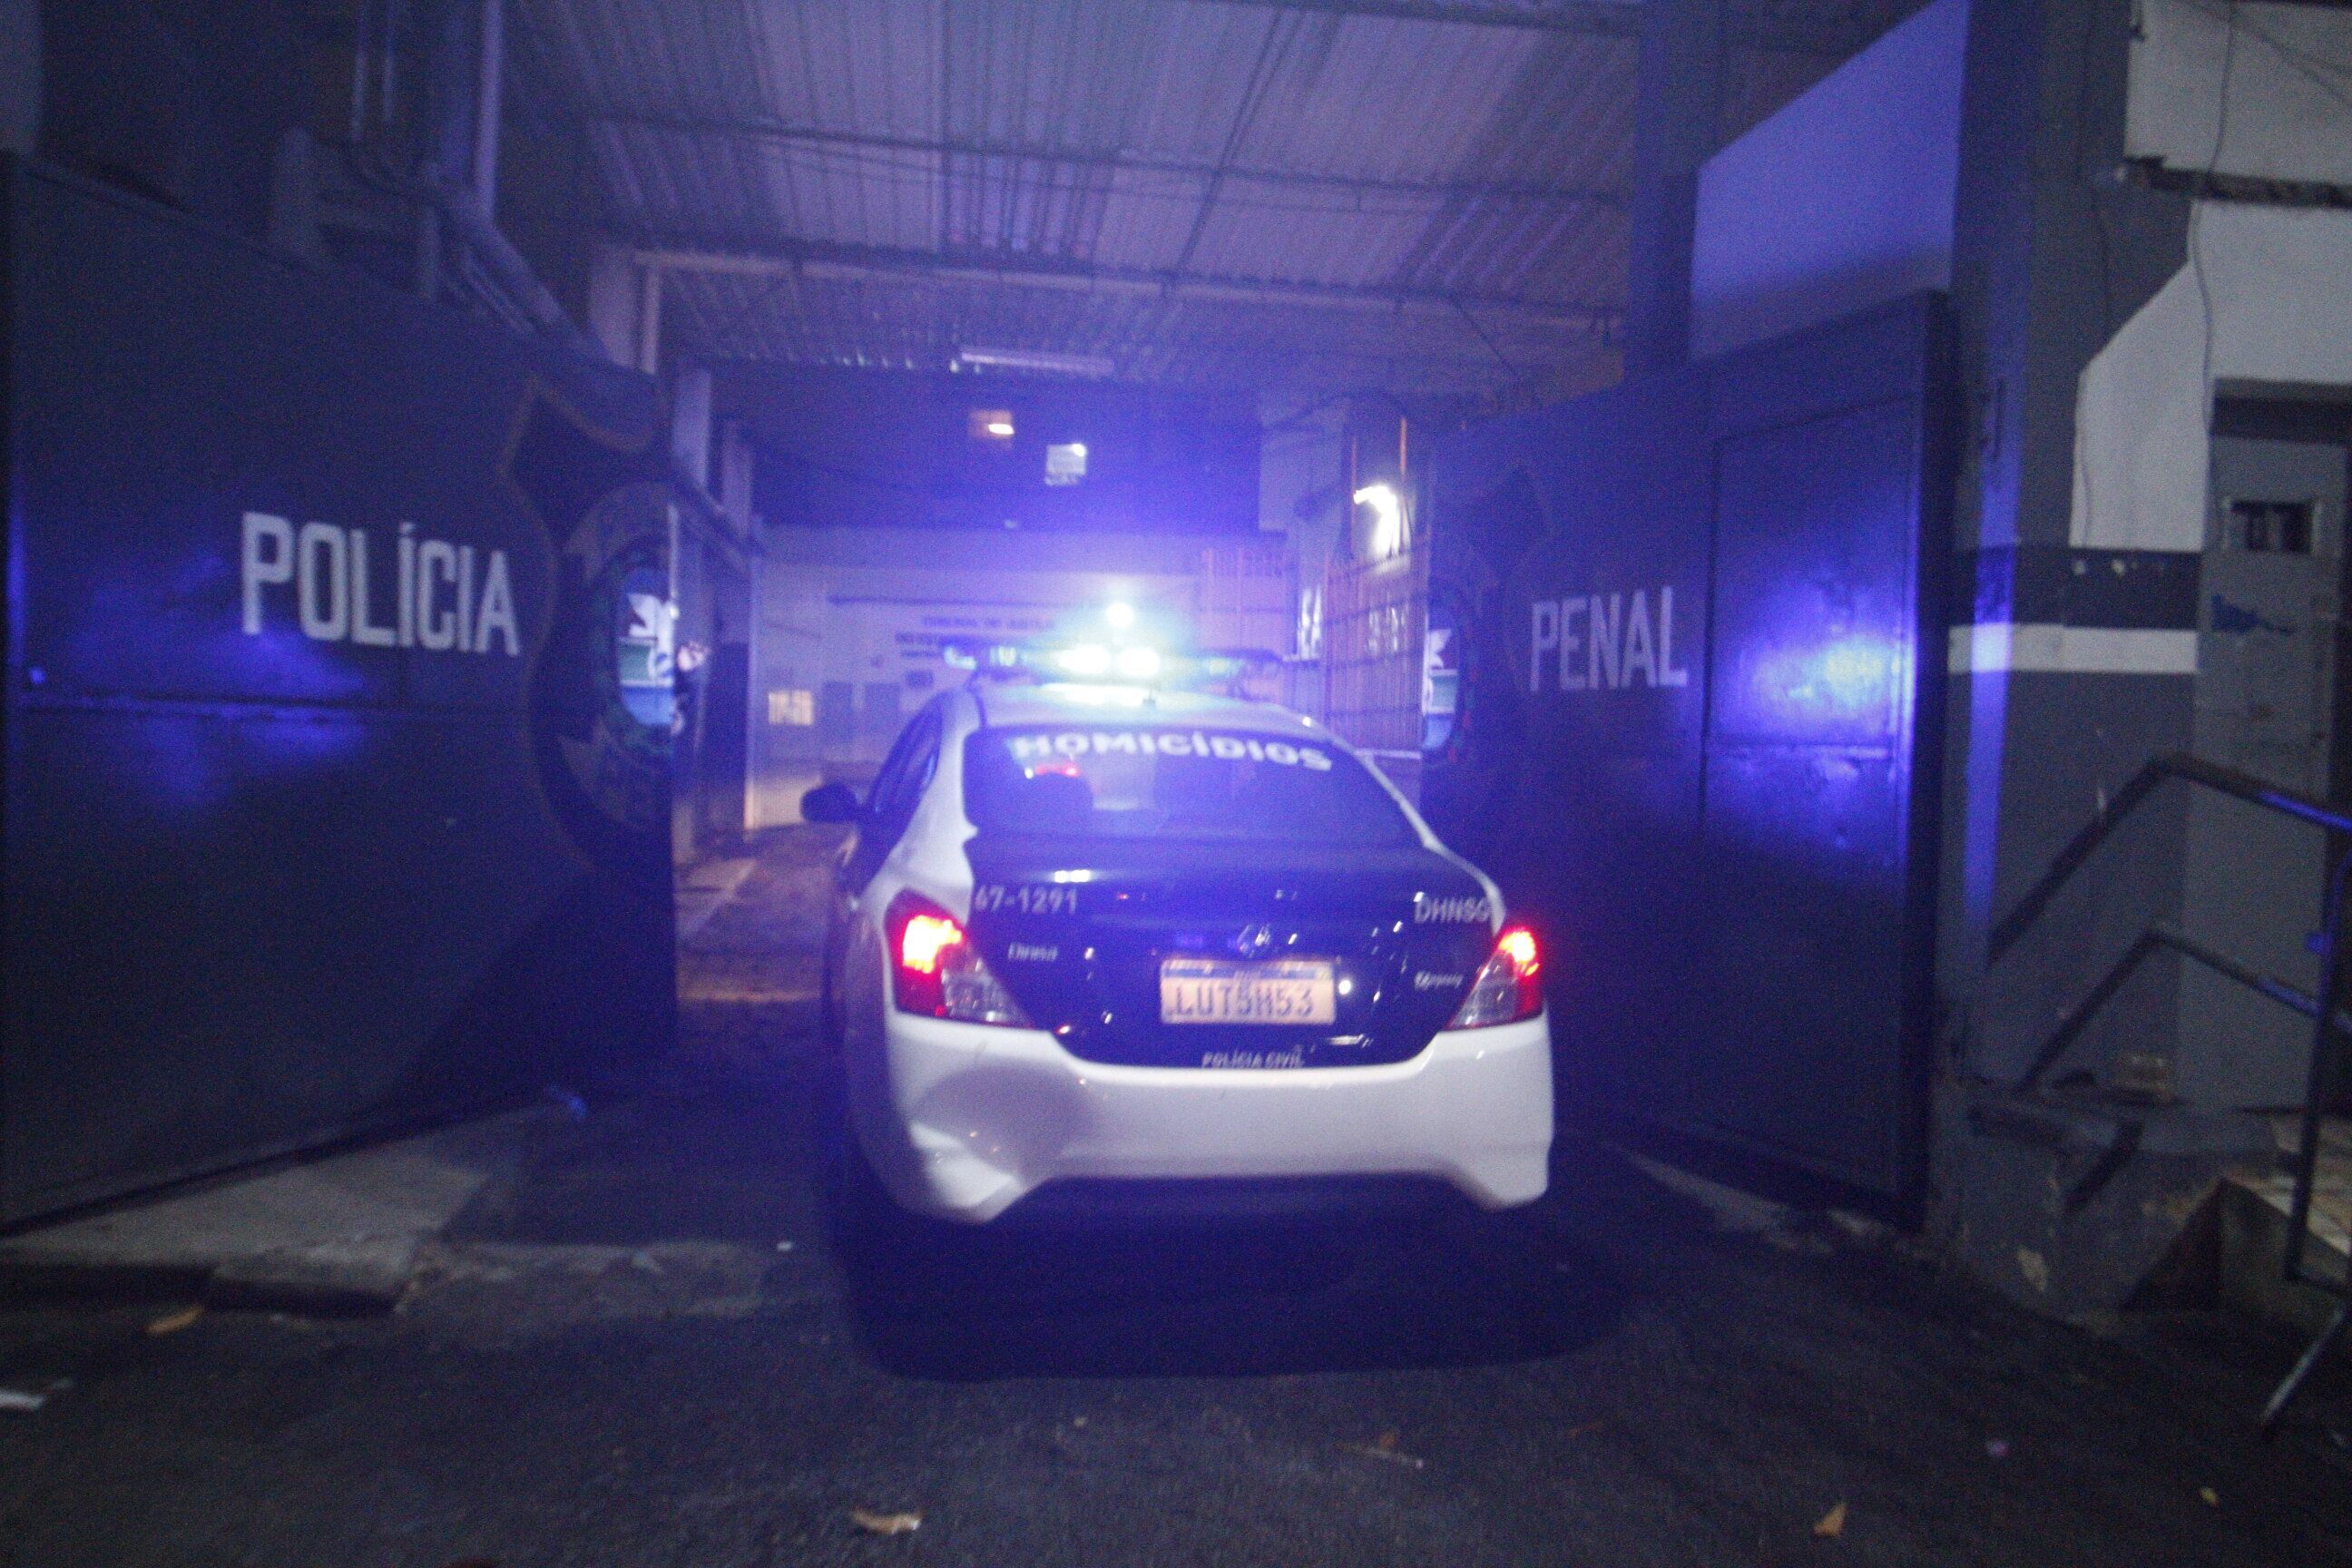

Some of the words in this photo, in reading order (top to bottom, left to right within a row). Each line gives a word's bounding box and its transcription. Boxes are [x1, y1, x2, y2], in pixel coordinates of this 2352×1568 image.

[242, 511, 520, 656] POLÍCIA
[1530, 585, 1688, 692] PENAL
[1014, 730, 1332, 771] HOMICÍDIOS
